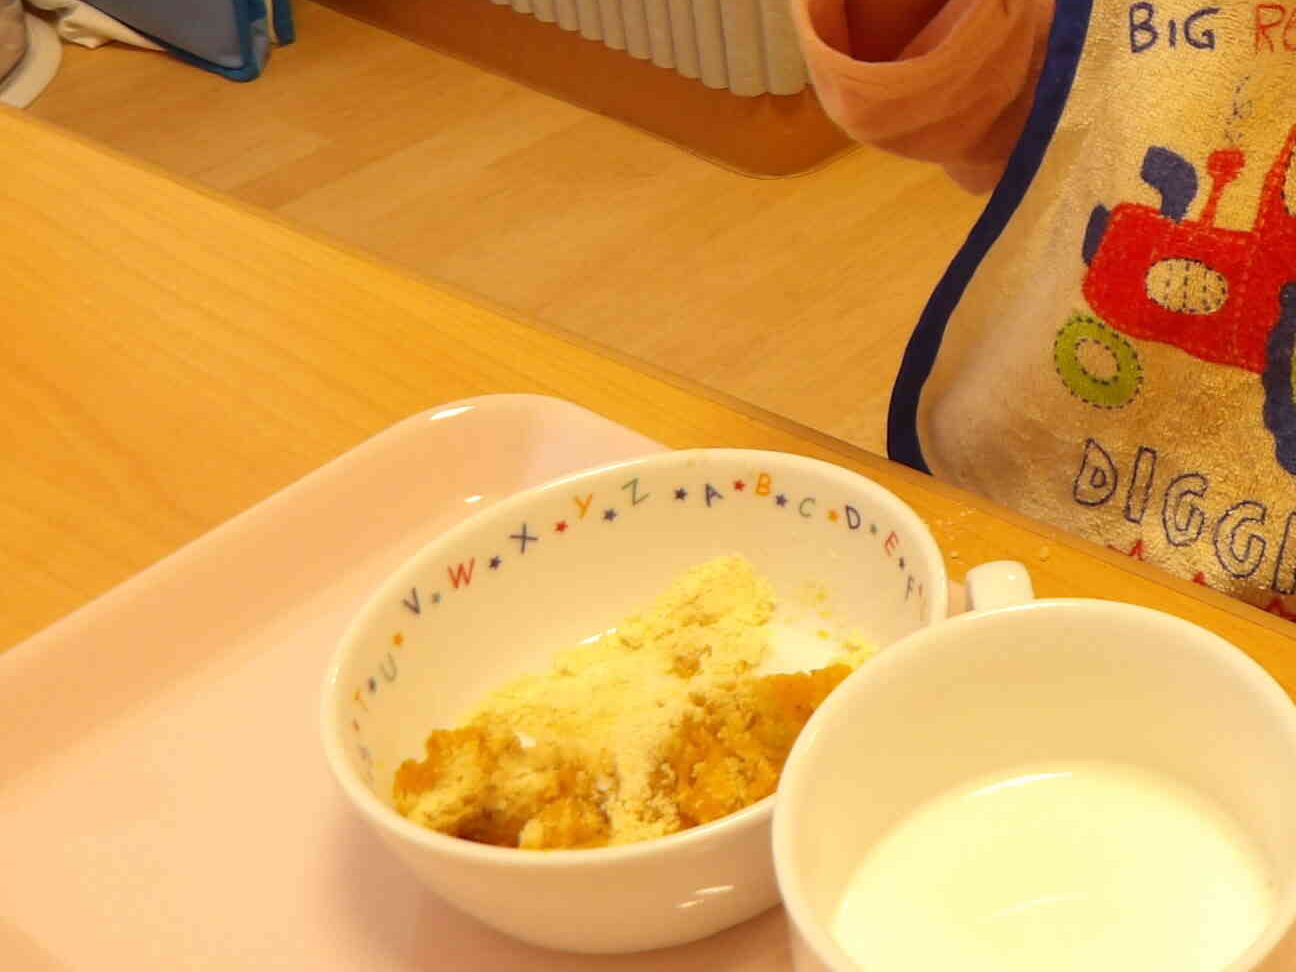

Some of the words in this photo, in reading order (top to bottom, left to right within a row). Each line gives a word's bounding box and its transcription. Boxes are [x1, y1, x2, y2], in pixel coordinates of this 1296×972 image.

[1128, 1, 1221, 54] BIG
[402, 586, 422, 616] V
[446, 556, 476, 590] W
[508, 522, 540, 555] X
[573, 492, 595, 521] Y
[620, 477, 650, 507] Z
[704, 483, 724, 507] A
[755, 471, 772, 497] B
[798, 496, 817, 519] C
[845, 504, 863, 531] D
